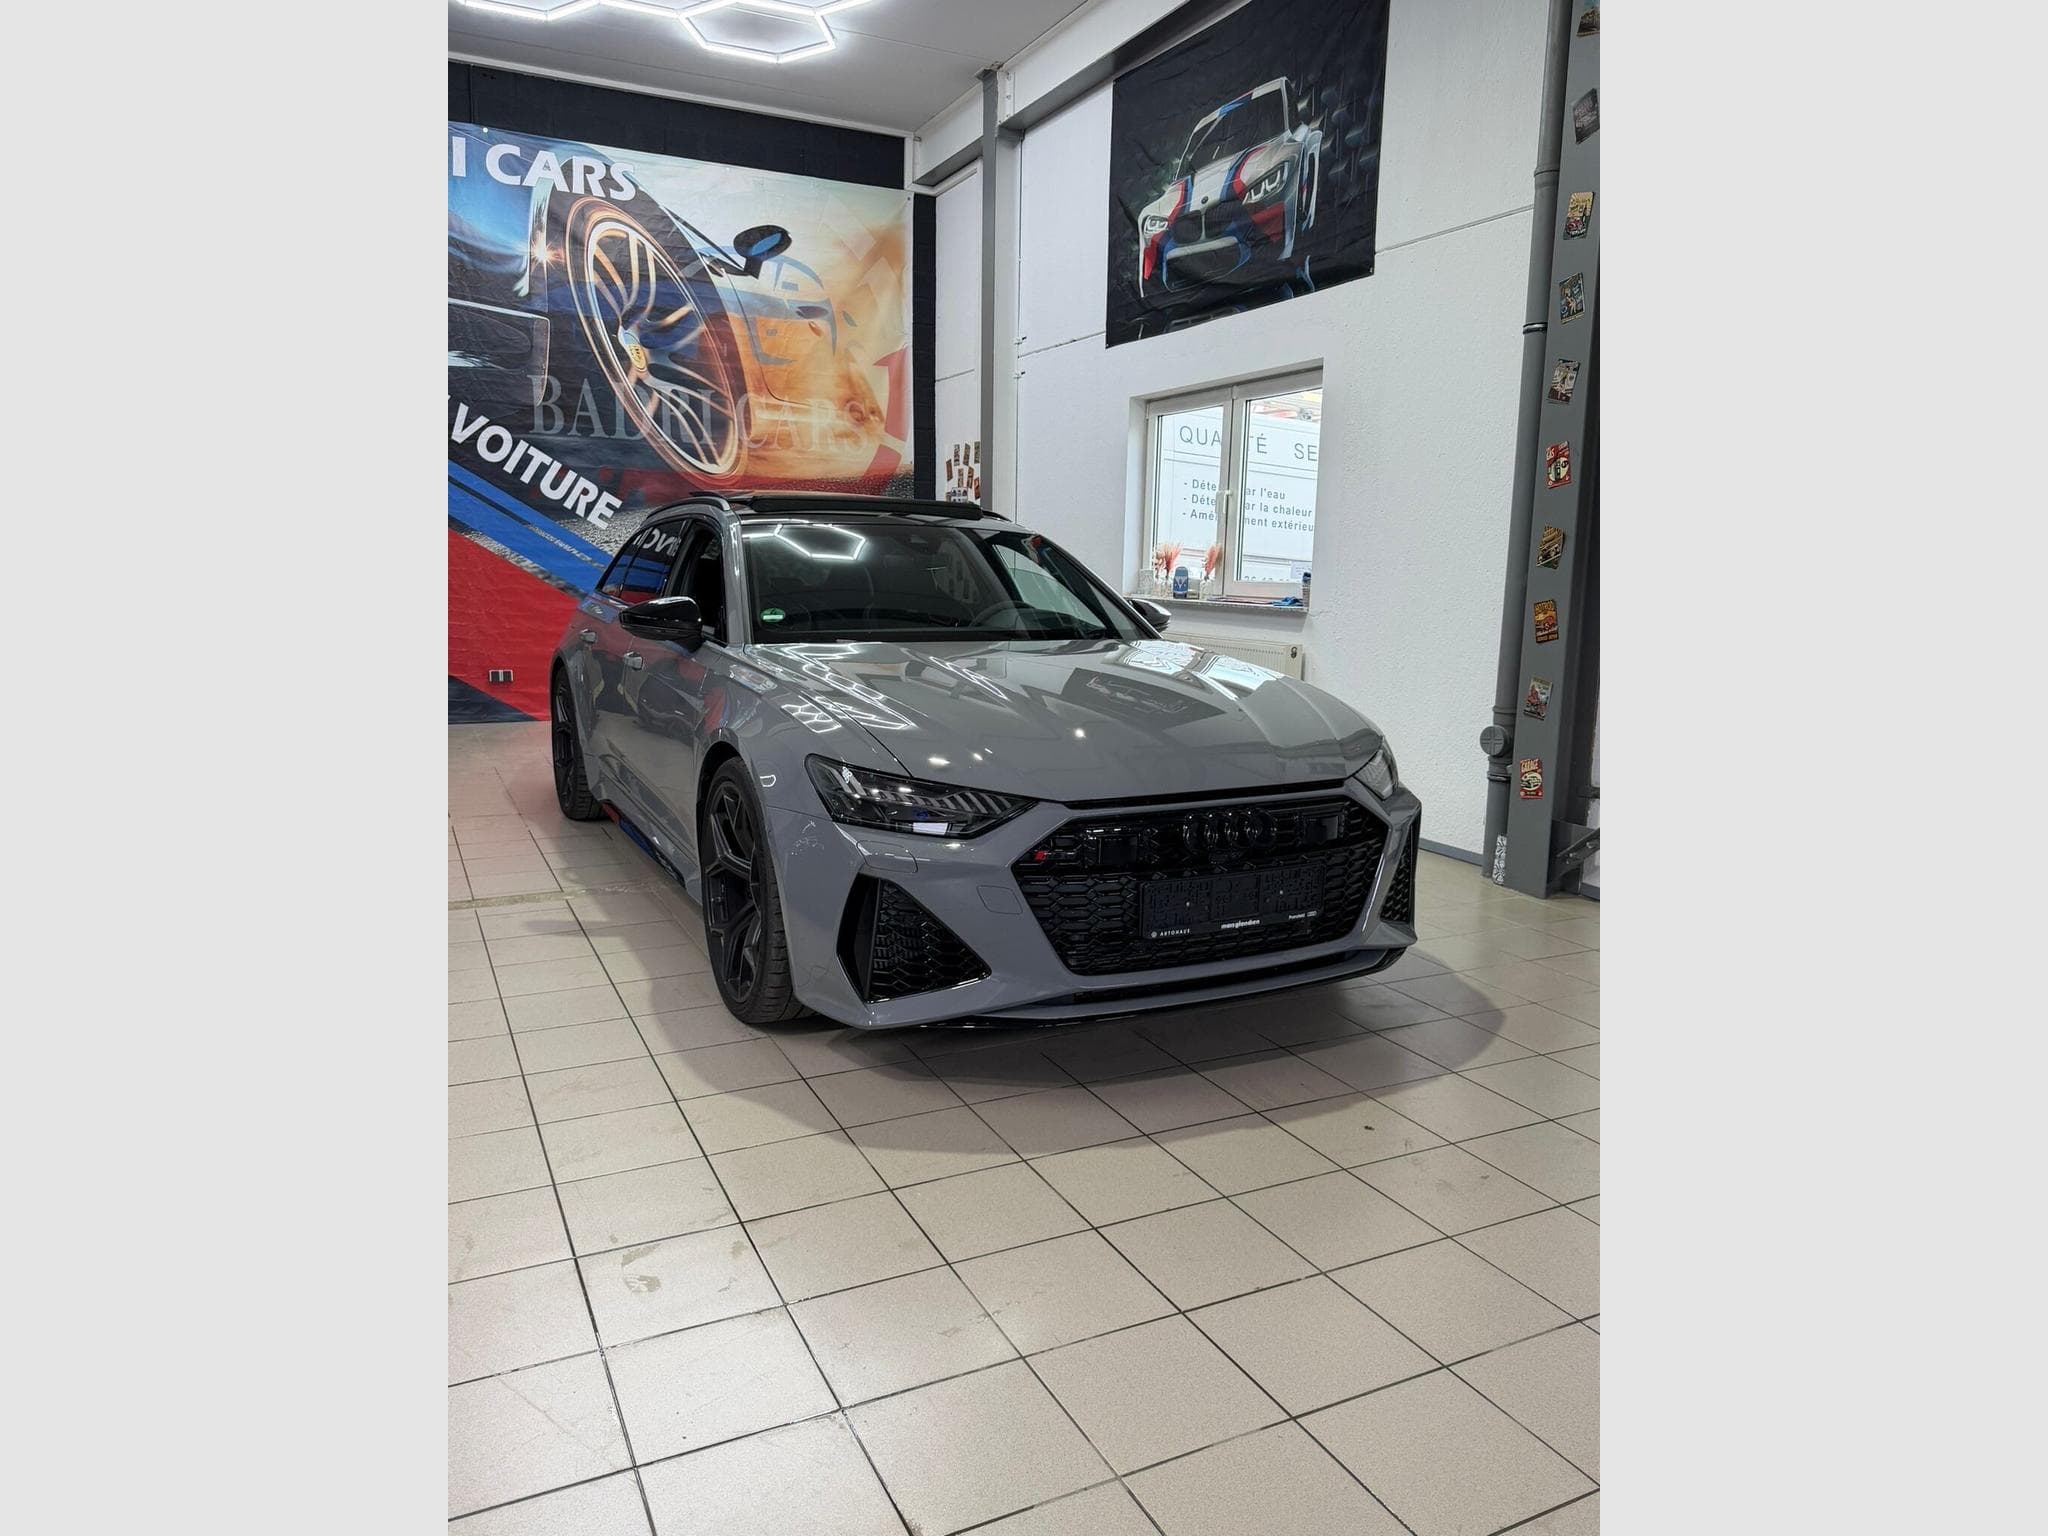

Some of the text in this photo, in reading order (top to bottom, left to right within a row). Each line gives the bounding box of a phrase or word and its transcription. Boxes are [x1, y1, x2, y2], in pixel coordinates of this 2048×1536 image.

[486, 144, 637, 201] CARS
[526, 374, 718, 446] BADRI
[451, 402, 623, 530] VOITURE
[1192, 479, 1286, 500] Déte ar l'eau
[1191, 494, 1312, 517] Déte ar la chaleur
